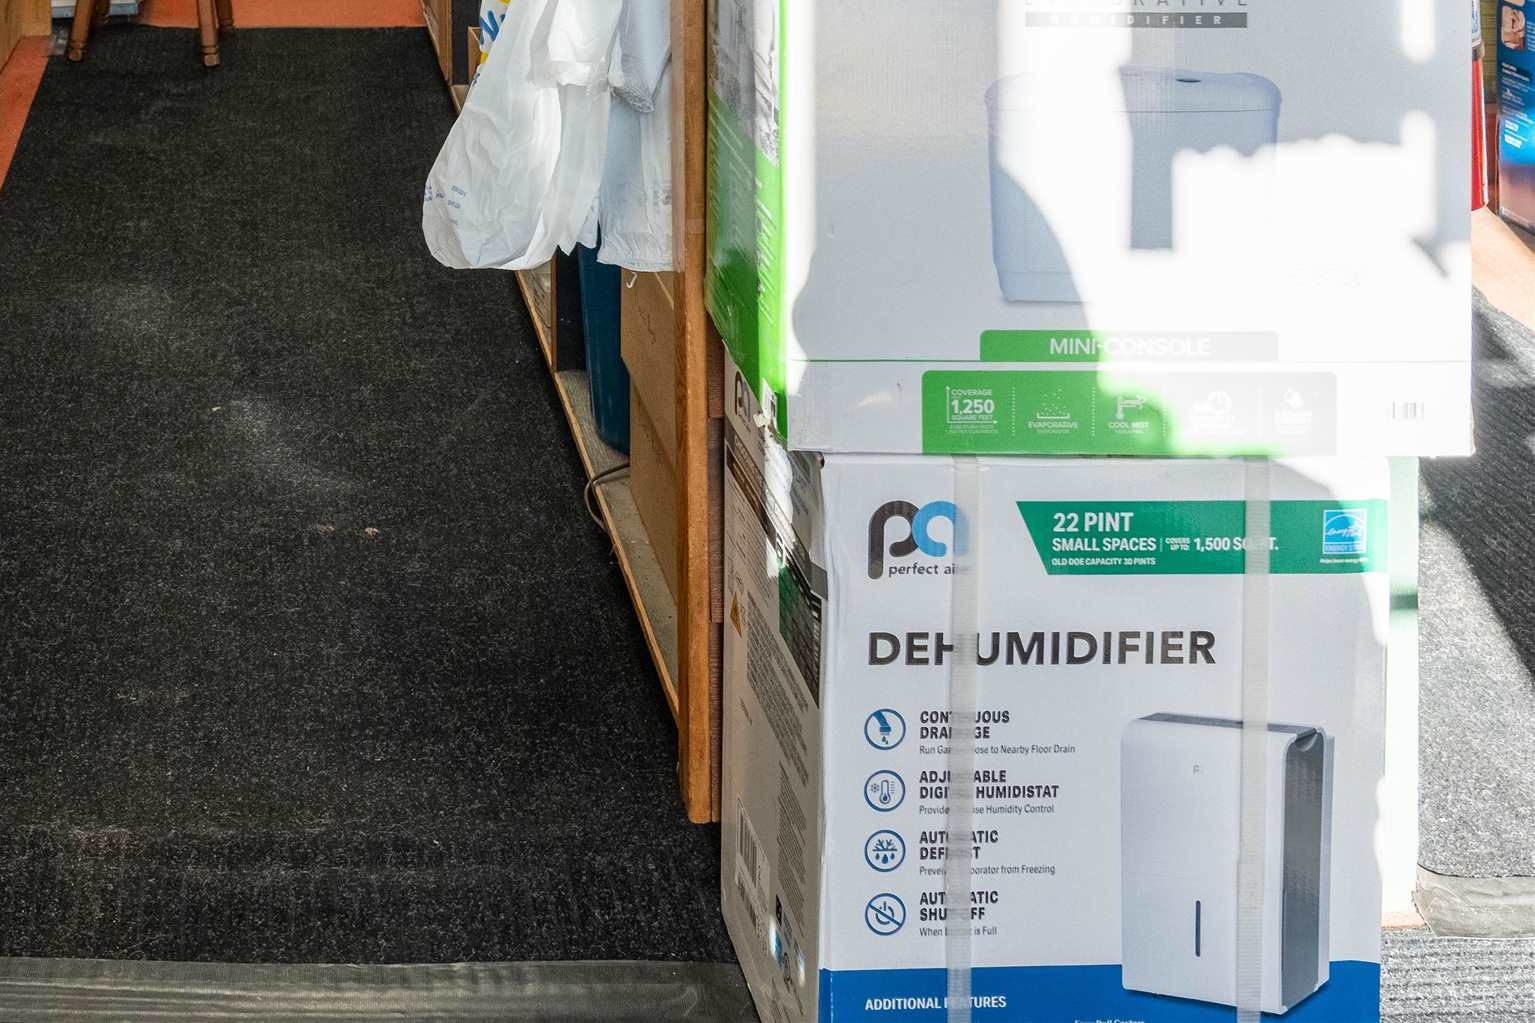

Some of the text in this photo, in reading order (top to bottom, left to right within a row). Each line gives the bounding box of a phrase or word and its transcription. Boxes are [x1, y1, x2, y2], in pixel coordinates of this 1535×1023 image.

[1049, 336, 1212, 356] MINI-CONSOLE
[950, 388, 993, 397] COVERAGE
[950, 398, 995, 415] 1,250
[1052, 512, 1134, 532] 22 PINT
[1052, 537, 1157, 552] SMALL SPACES
[1193, 536, 1230, 552] 1,500
[1085, 557, 1156, 566] CAPACITY PINTS
[888, 562, 939, 578] perfect
[868, 631, 1217, 666] DEHUMIDIFIER
[1000, 744, 1076, 756] Nearby Floor Drain
[975, 785, 1059, 799] HUMIDISTAT
[985, 803, 1055, 816] Humidity Control
[1021, 864, 1056, 876] Freezing
[919, 927, 943, 937] When
[864, 997, 942, 1011] ADDITIONAL
